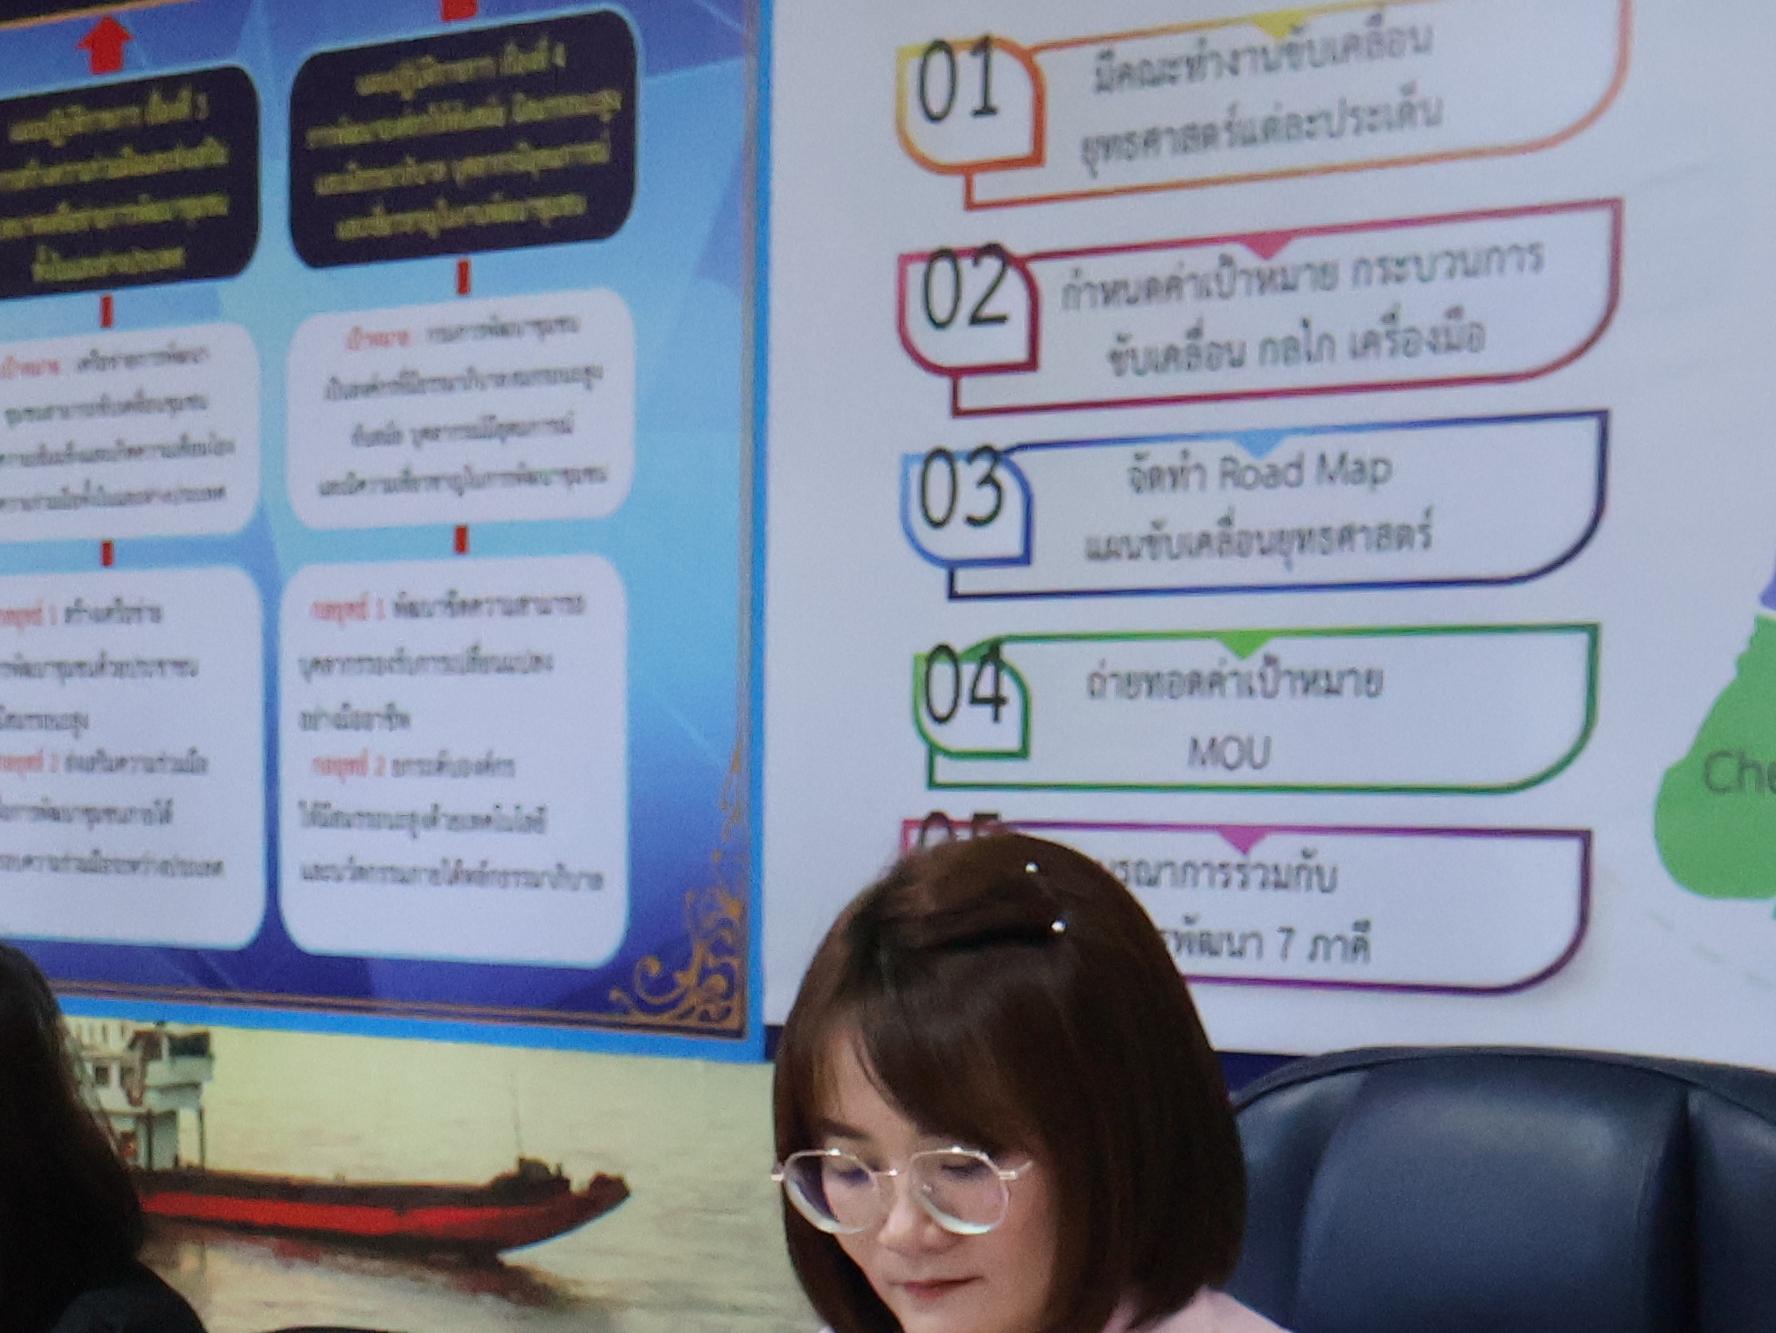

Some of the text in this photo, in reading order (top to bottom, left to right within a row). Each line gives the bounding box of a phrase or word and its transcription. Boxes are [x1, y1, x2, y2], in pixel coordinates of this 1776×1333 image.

[919, 34, 999, 121] 01
[921, 243, 1009, 330] 02
[1353, 240, 1544, 289] กระบวนการ
[1107, 318, 1247, 378] ขับเคลื่อน
[1350, 304, 1487, 359] เครื่องมือ
[920, 445, 1004, 528] 03
[1128, 450, 1393, 498] จัดทำ Road Map
[924, 643, 1008, 724] 04
[1188, 735, 1272, 770] MOU
[1277, 926, 1296, 962] 7
